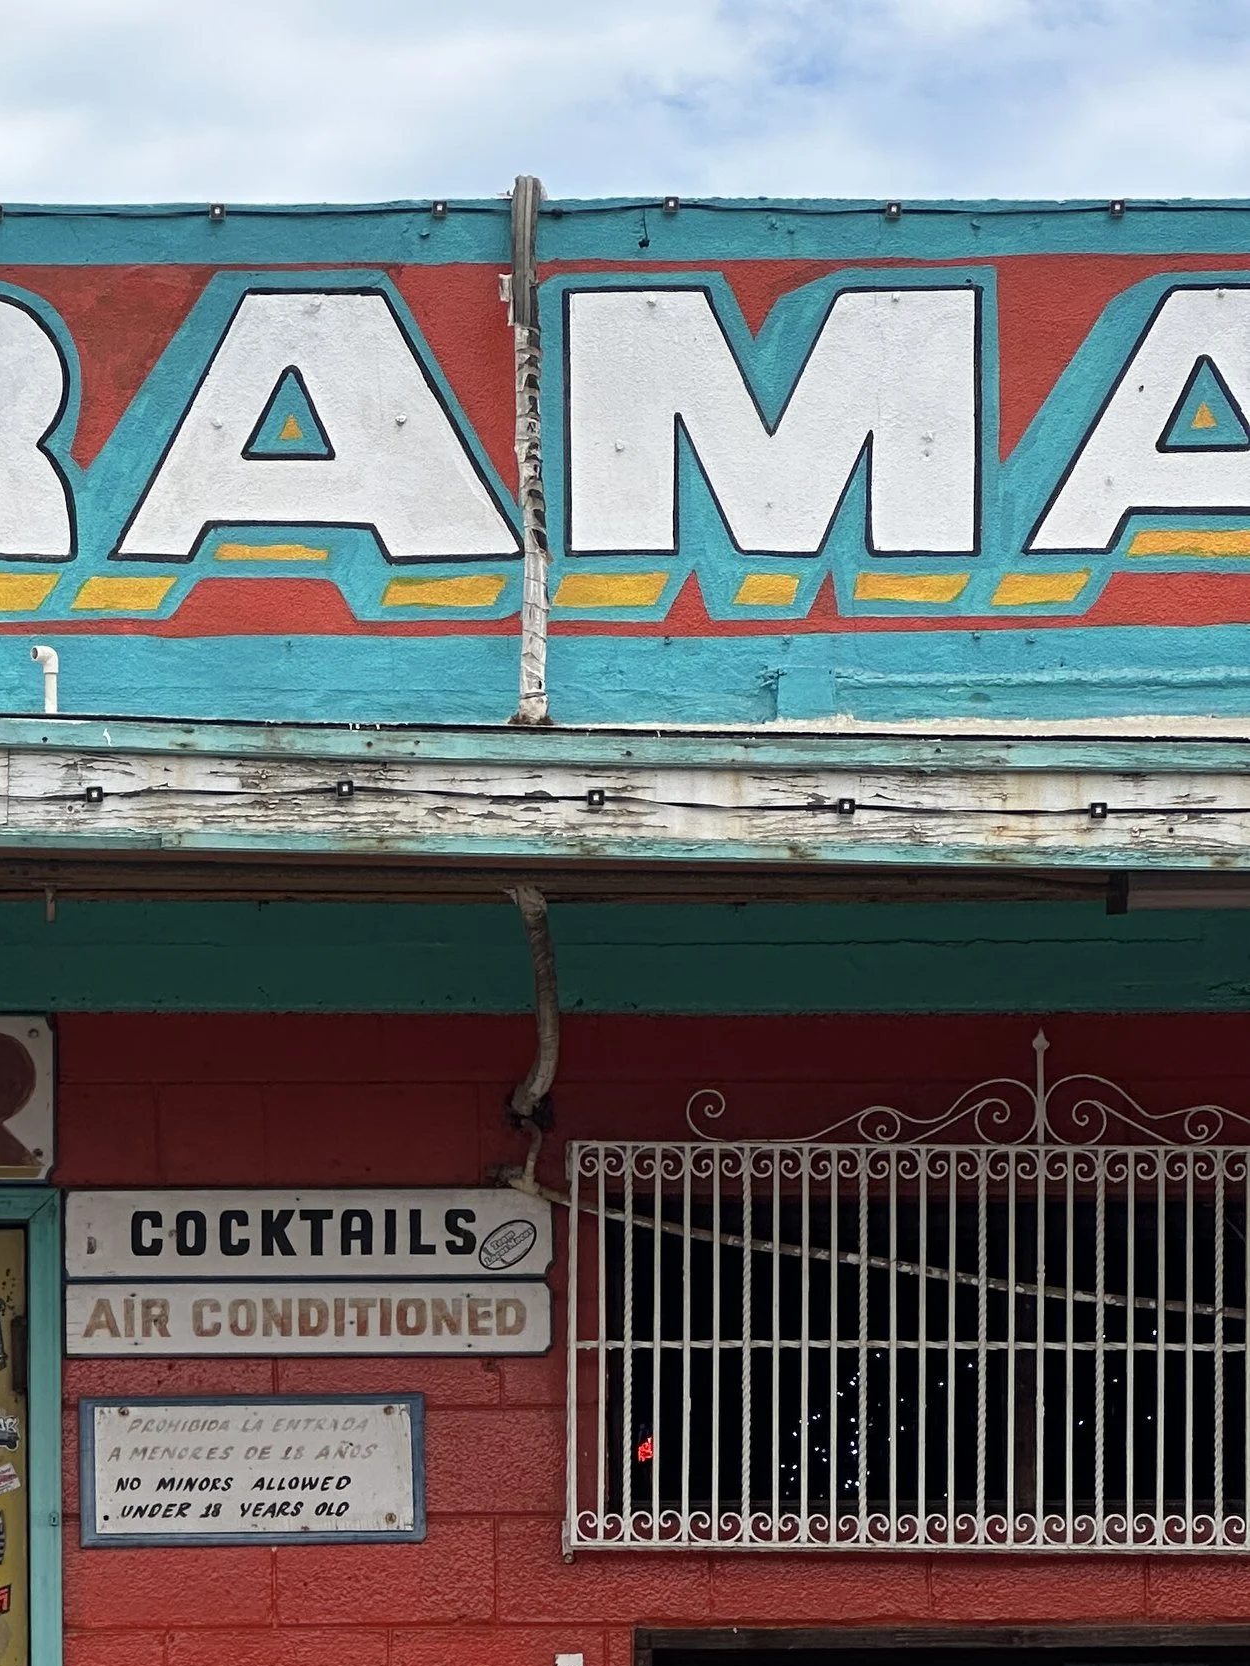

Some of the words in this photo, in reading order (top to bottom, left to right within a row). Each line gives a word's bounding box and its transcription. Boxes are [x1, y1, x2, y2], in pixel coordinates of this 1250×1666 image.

[130, 1208, 477, 1257] COCKTAILS
[82, 1298, 171, 1338] AIR
[192, 1297, 528, 1338] CONDITIONED
[128, 1418, 231, 1433] PROHIBIDA
[241, 1419, 262, 1433] LA
[272, 1418, 370, 1433] ENTRADA
[107, 1446, 121, 1462] A
[128, 1445, 235, 1462] MENORES
[244, 1445, 271, 1460] DE
[284, 1445, 305, 1459] 18
[314, 1440, 379, 1461] AÑOS
[115, 1477, 141, 1493] NO
[155, 1477, 234, 1493] MINORS
[251, 1475, 352, 1492] ALLOWED
[121, 1502, 191, 1519] UNDER
[200, 1502, 222, 1518] 18
[240, 1501, 304, 1518] YEARS
[315, 1501, 350, 1517] OLD
